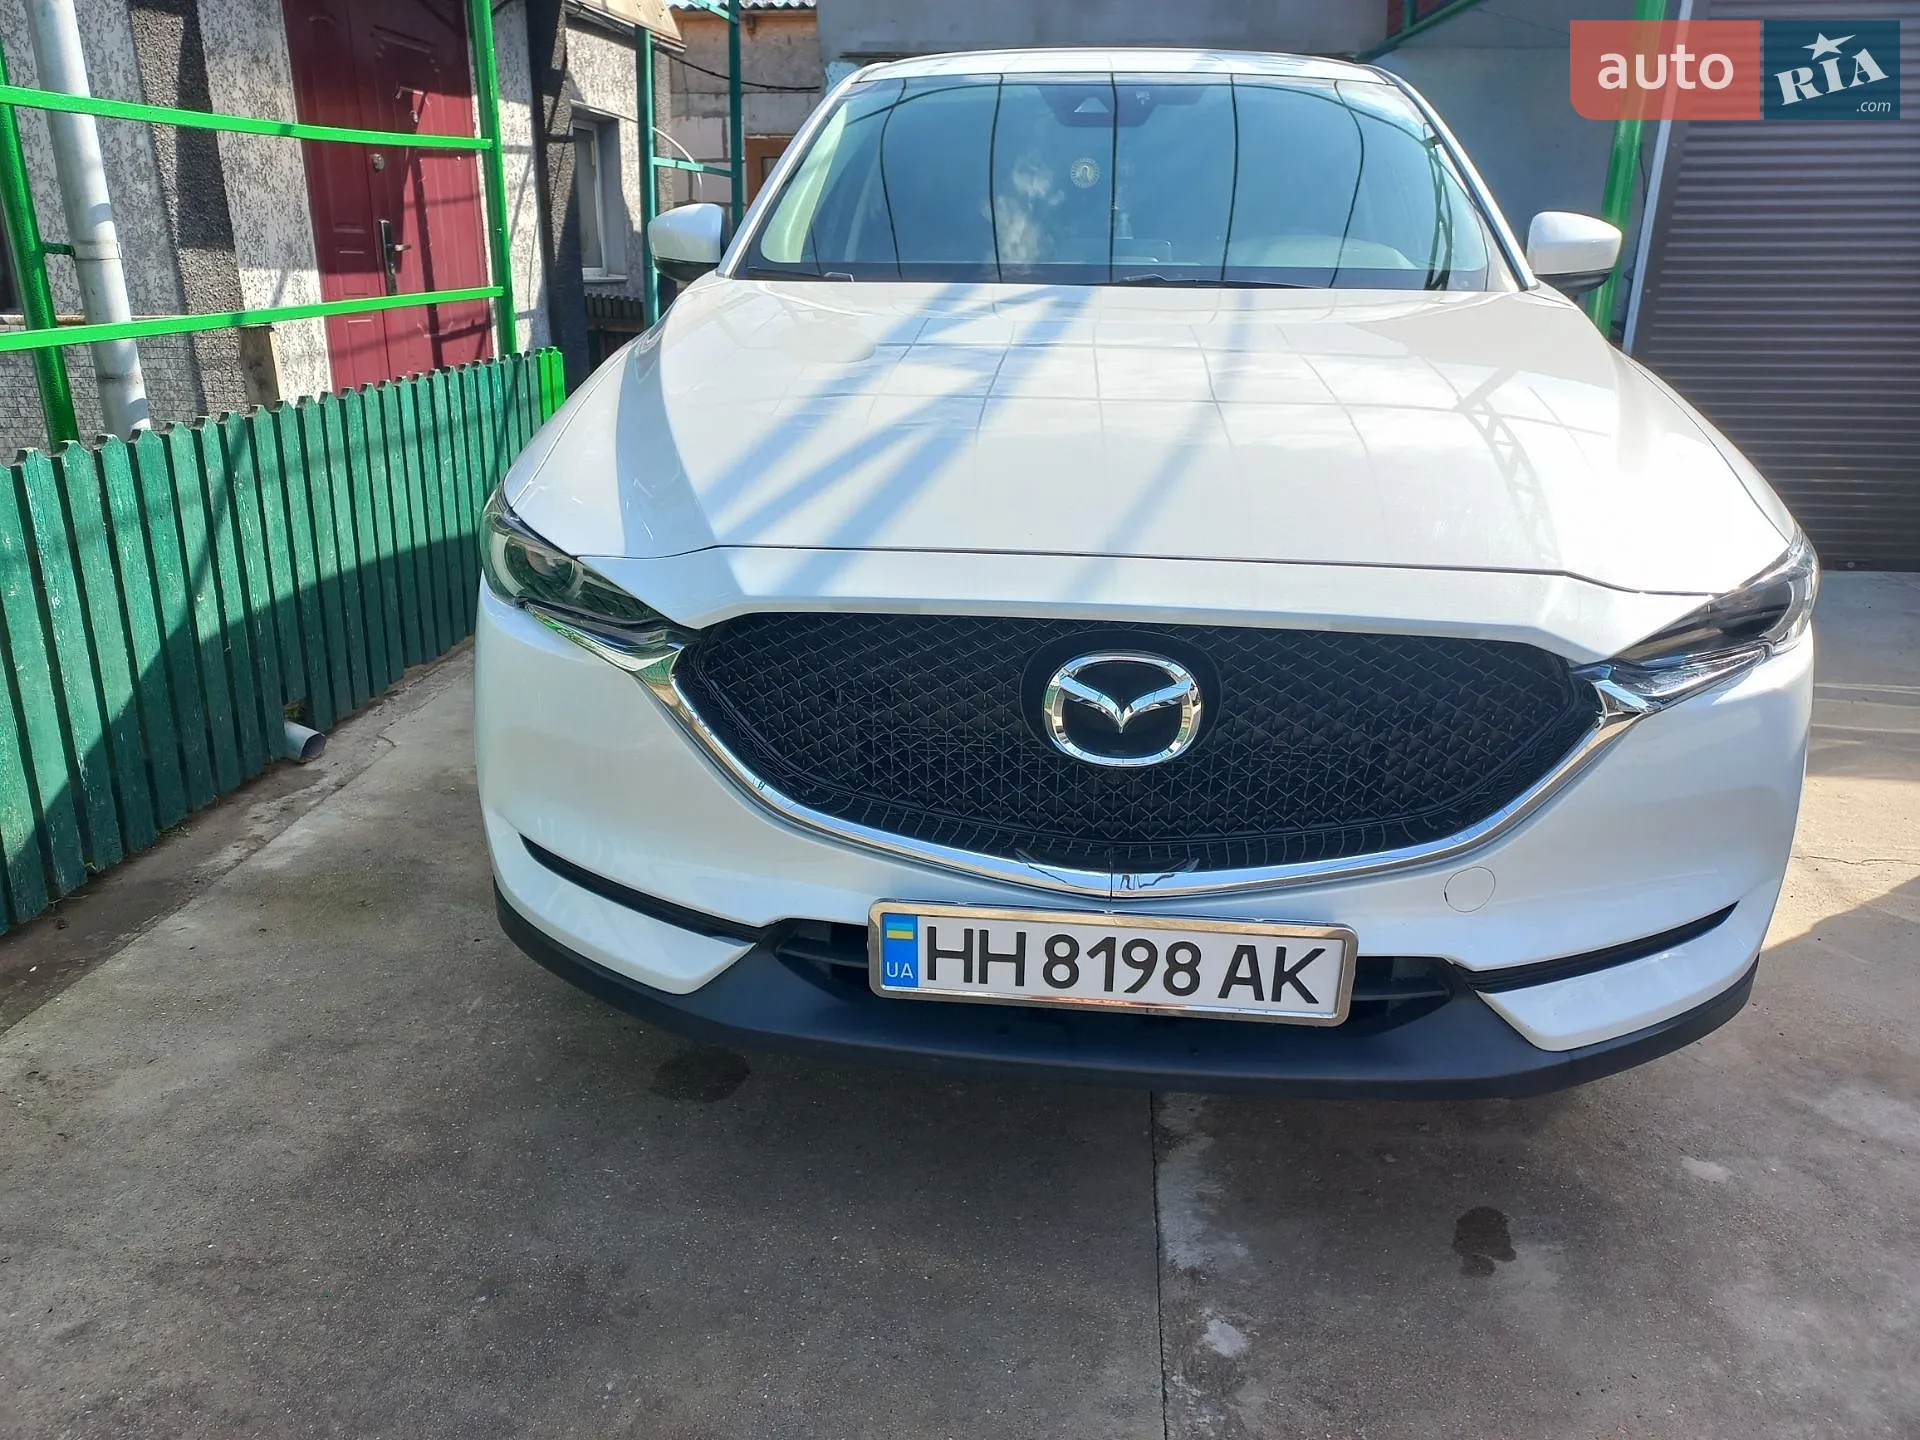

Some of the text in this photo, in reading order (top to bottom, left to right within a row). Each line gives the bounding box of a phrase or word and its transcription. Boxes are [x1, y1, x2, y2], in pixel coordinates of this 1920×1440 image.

[885, 962, 914, 980] UA
[926, 926, 1326, 1004] HH 8198 AK
